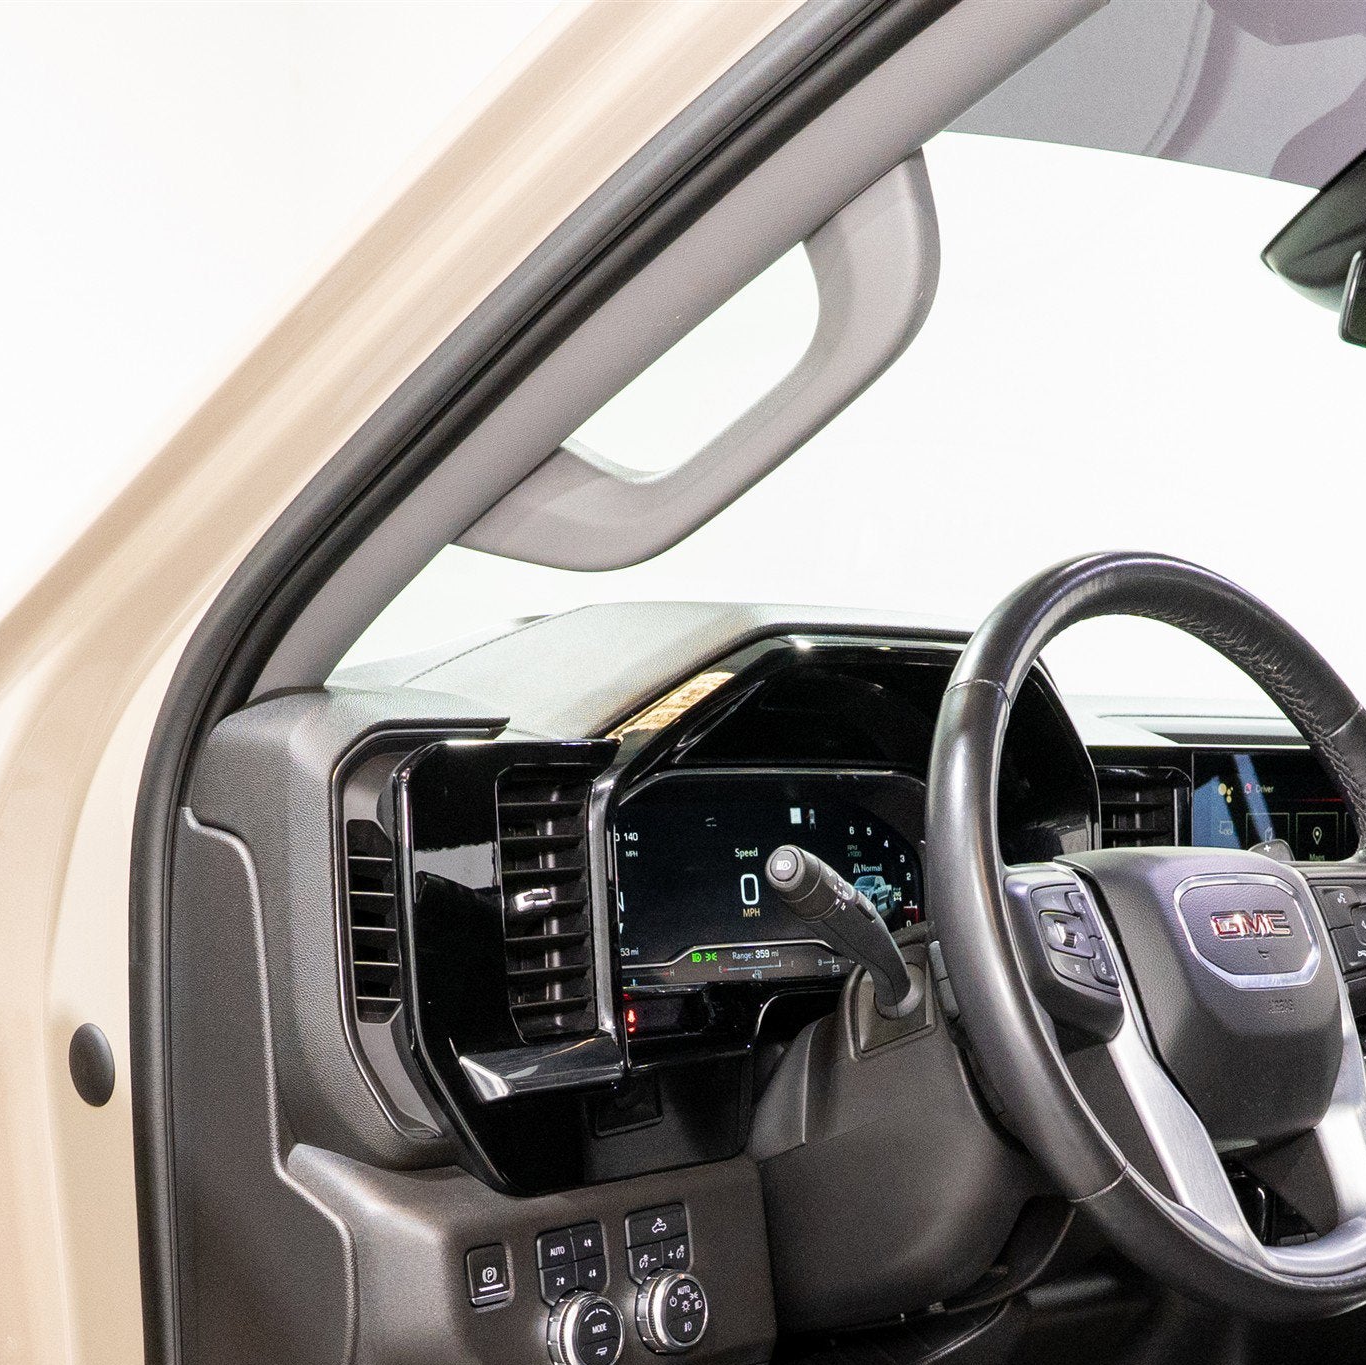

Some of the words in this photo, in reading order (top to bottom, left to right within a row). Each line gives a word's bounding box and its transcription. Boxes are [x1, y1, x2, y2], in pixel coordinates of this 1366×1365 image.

[1255, 785, 1275, 794] Driver
[848, 826, 855, 835] 6
[866, 827, 872, 836] 5
[623, 832, 639, 842] 140
[883, 839, 889, 848] 4
[625, 850, 639, 858] MPH
[734, 847, 759, 860] Speed
[899, 854, 906, 863] 3
[860, 863, 883, 872] Normal
[906, 872, 912, 881] 2
[740, 873, 760, 906] 0
[742, 907, 761, 918] MPH
[1210, 909, 1293, 940] GMC
[732, 951, 754, 962] Range:
[754, 949, 770, 959] 359
[771, 949, 780, 957] mi
[549, 1246, 566, 1257] AUTO
[676, 1285, 691, 1296] AUTO
[591, 1323, 608, 1335] MODE
